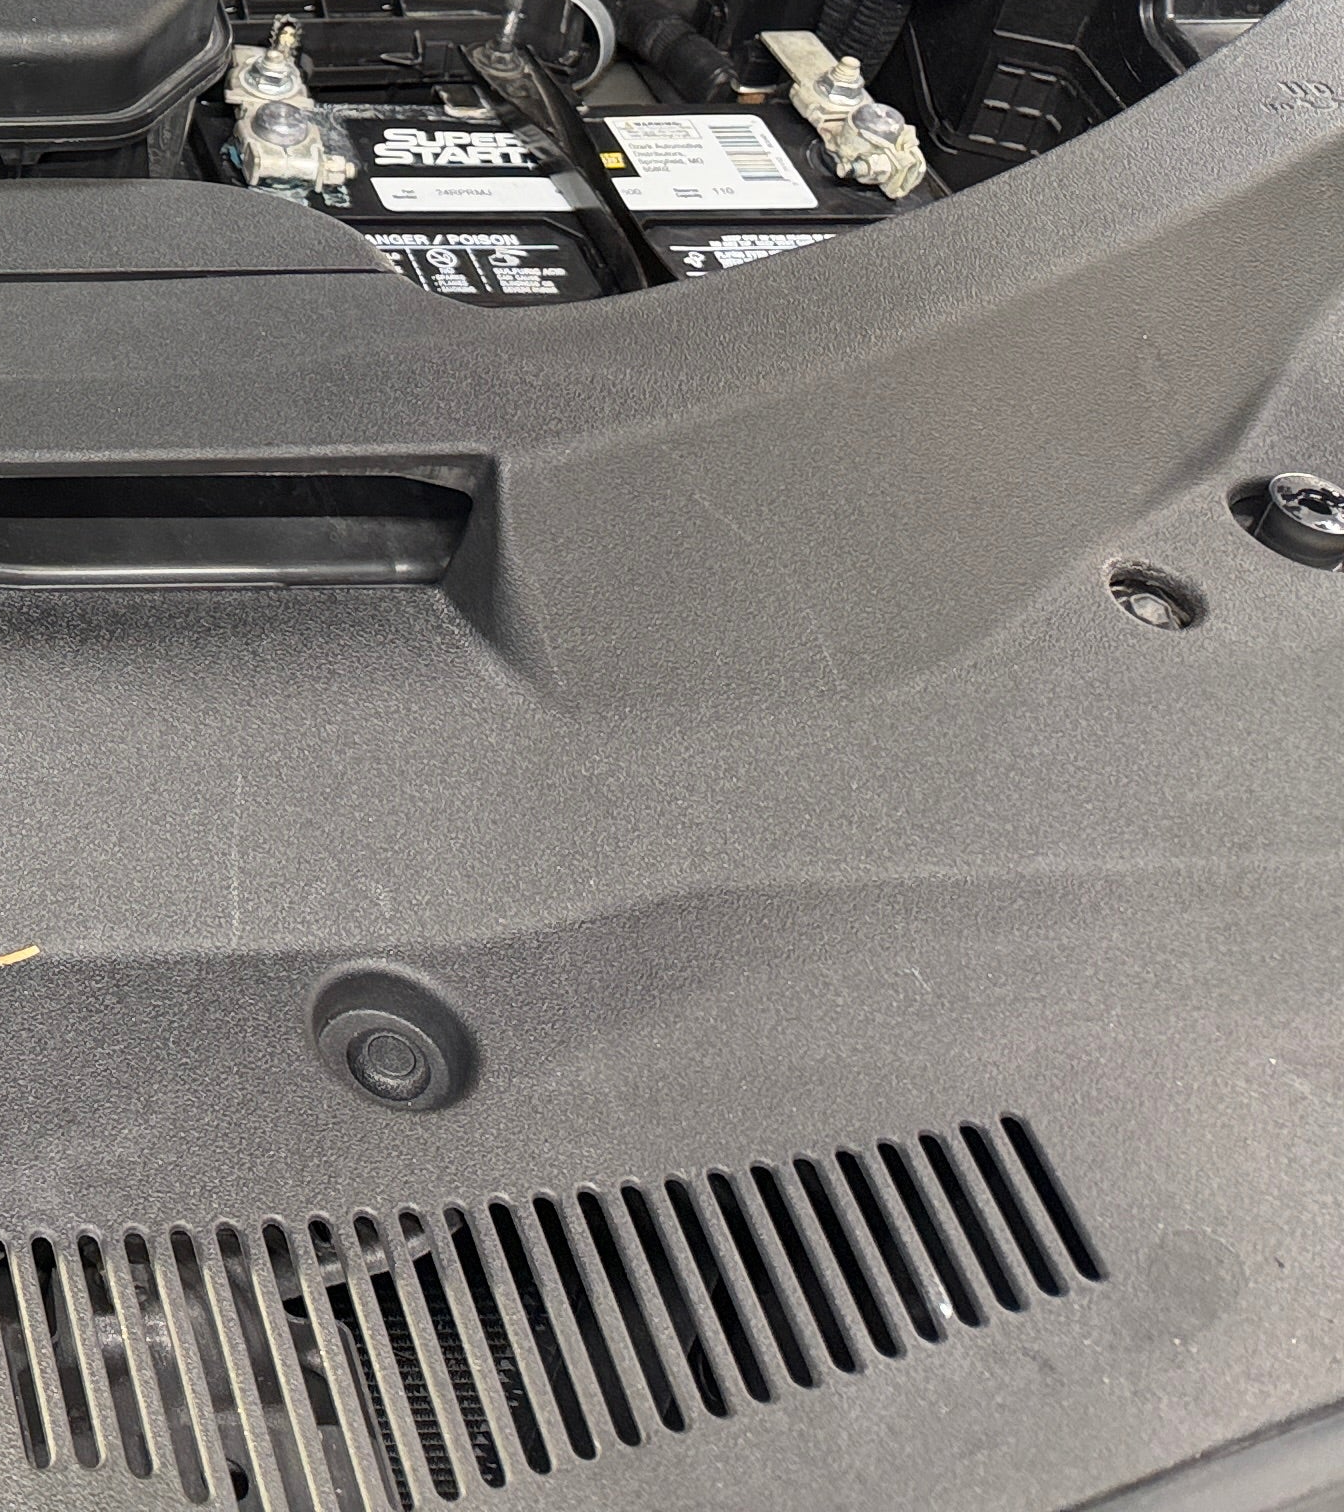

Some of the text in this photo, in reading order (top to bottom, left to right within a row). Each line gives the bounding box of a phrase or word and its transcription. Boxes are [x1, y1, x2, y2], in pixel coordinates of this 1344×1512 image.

[383, 128, 524, 148] SUPER
[374, 143, 531, 167] START
[364, 234, 430, 246] ANGER
[446, 234, 520, 246] POISON
